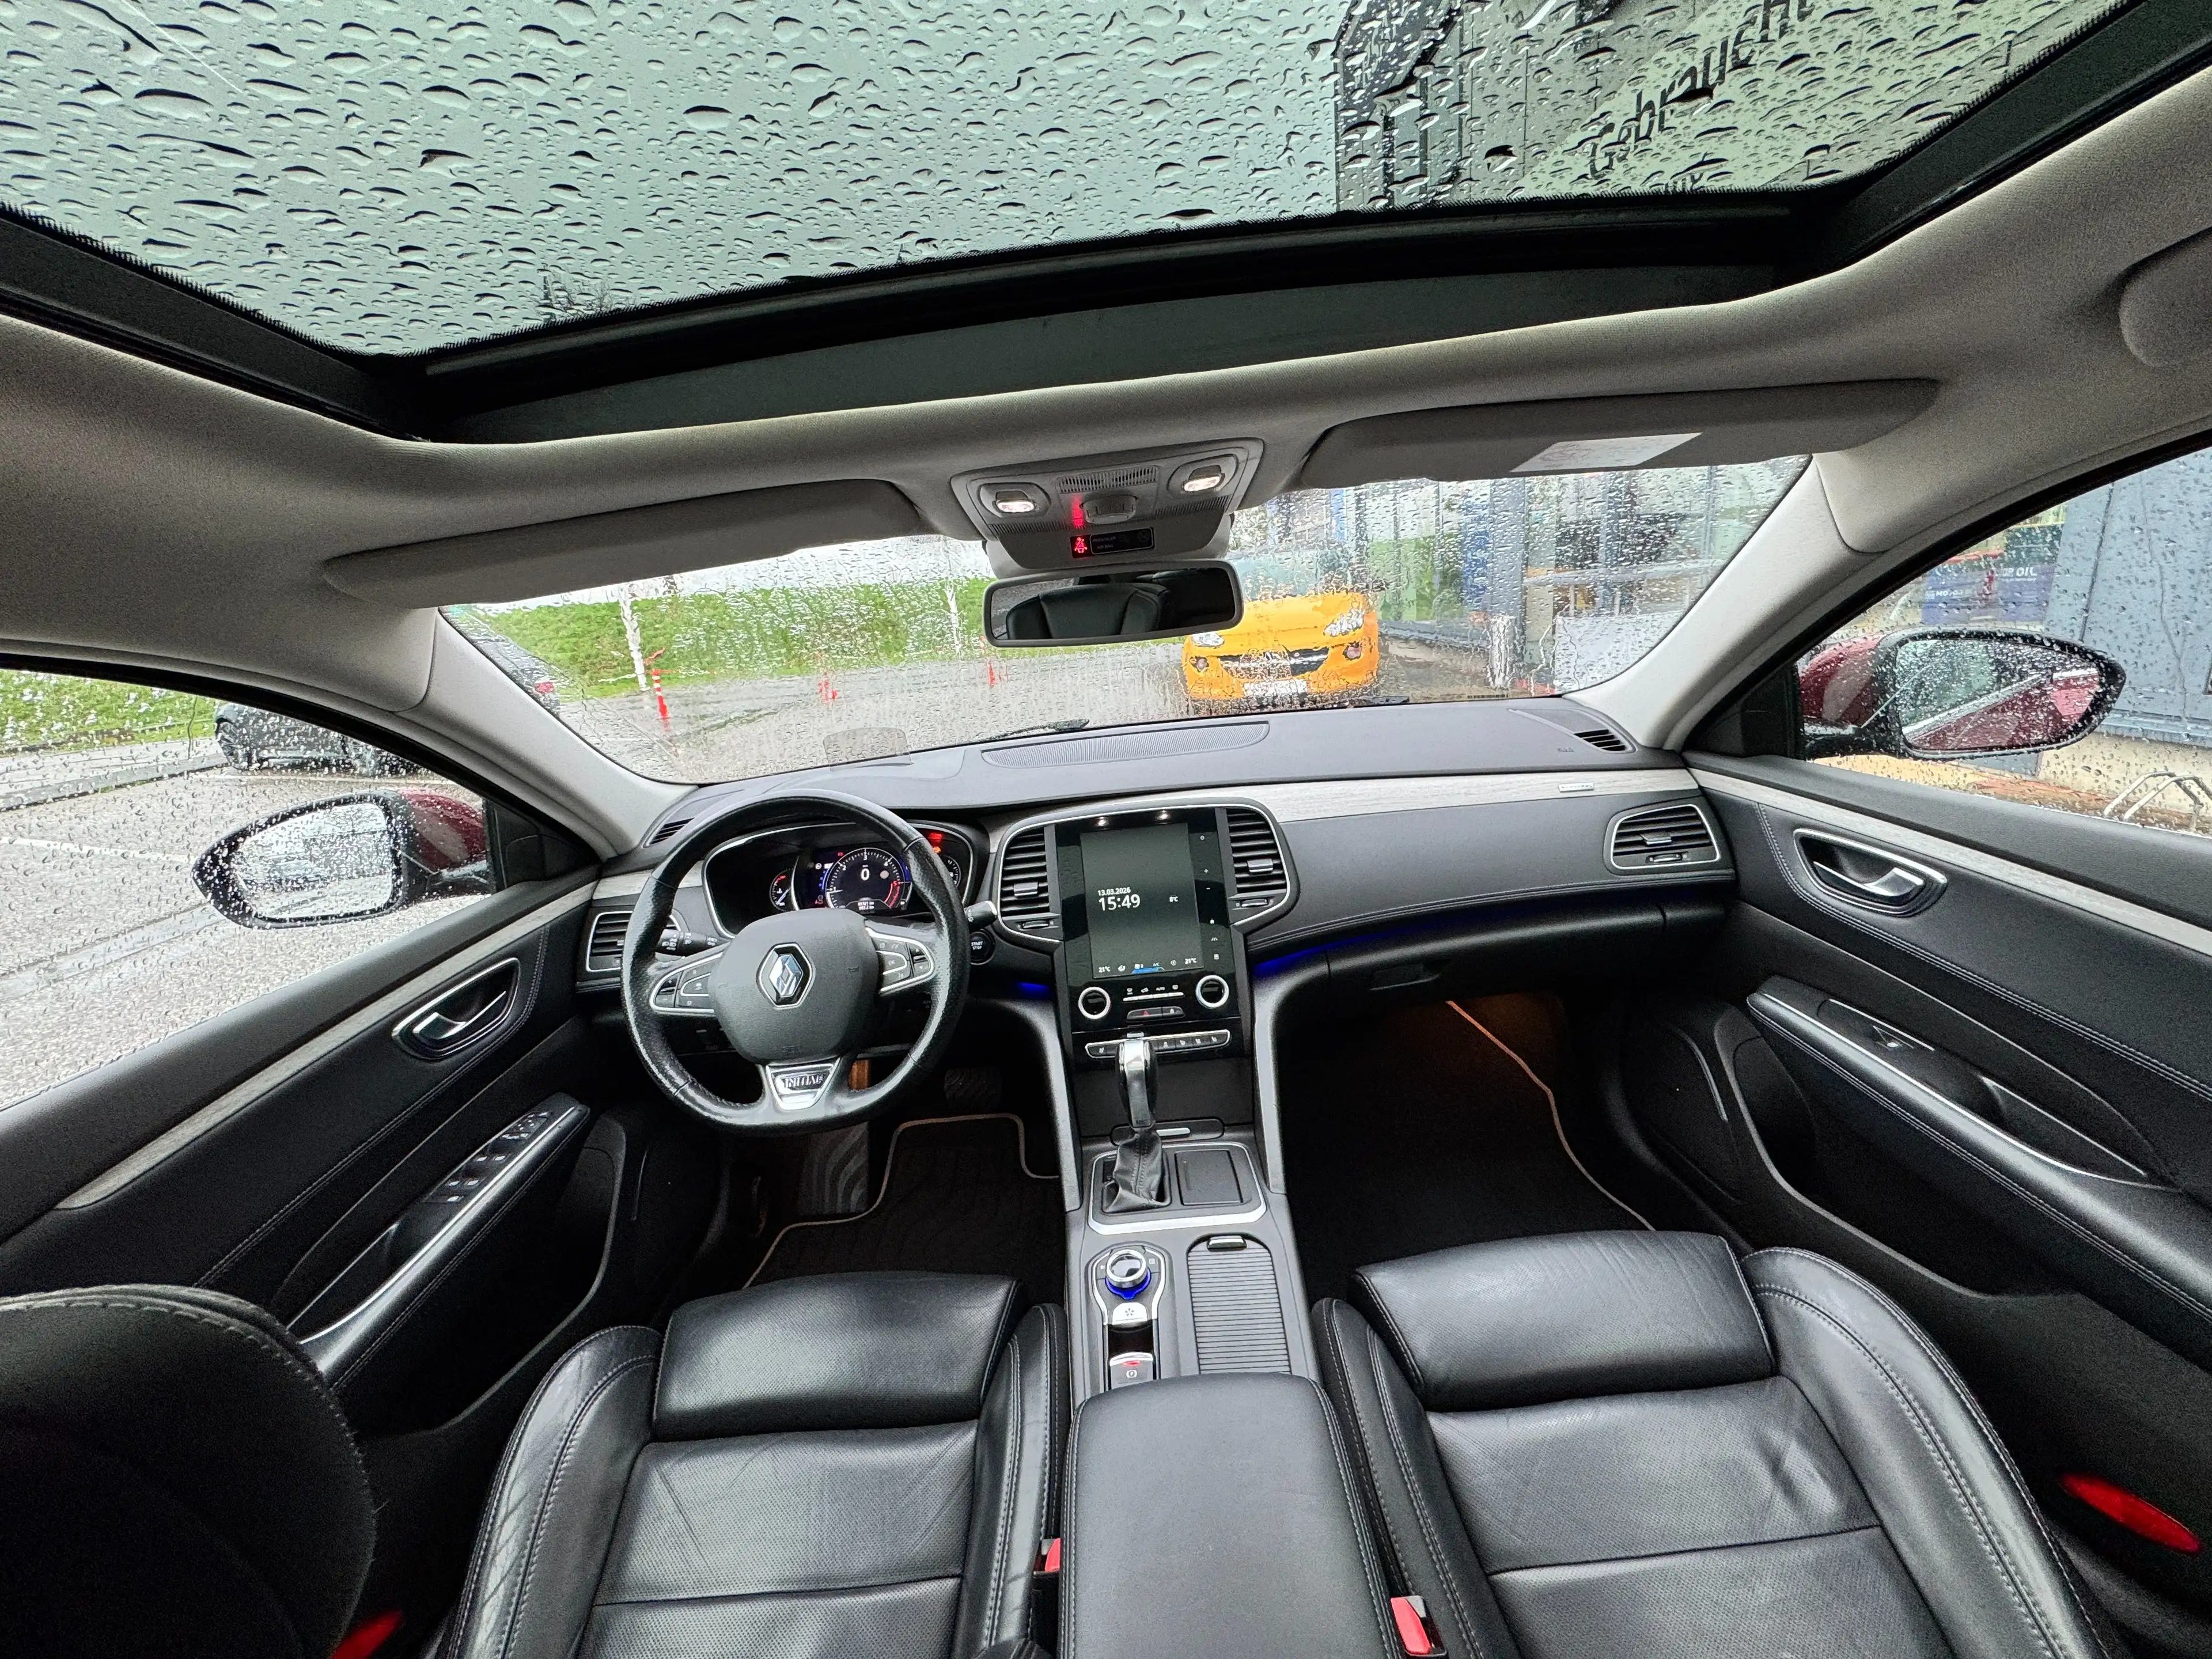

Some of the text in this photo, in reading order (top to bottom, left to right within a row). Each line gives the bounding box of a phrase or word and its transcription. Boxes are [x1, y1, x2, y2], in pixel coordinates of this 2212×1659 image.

[2016, 566, 2038, 577] OIL
[860, 868, 870, 881] 0
[1097, 887, 1131, 896] 13.03.2026
[1099, 893, 1141, 911] 15:49
